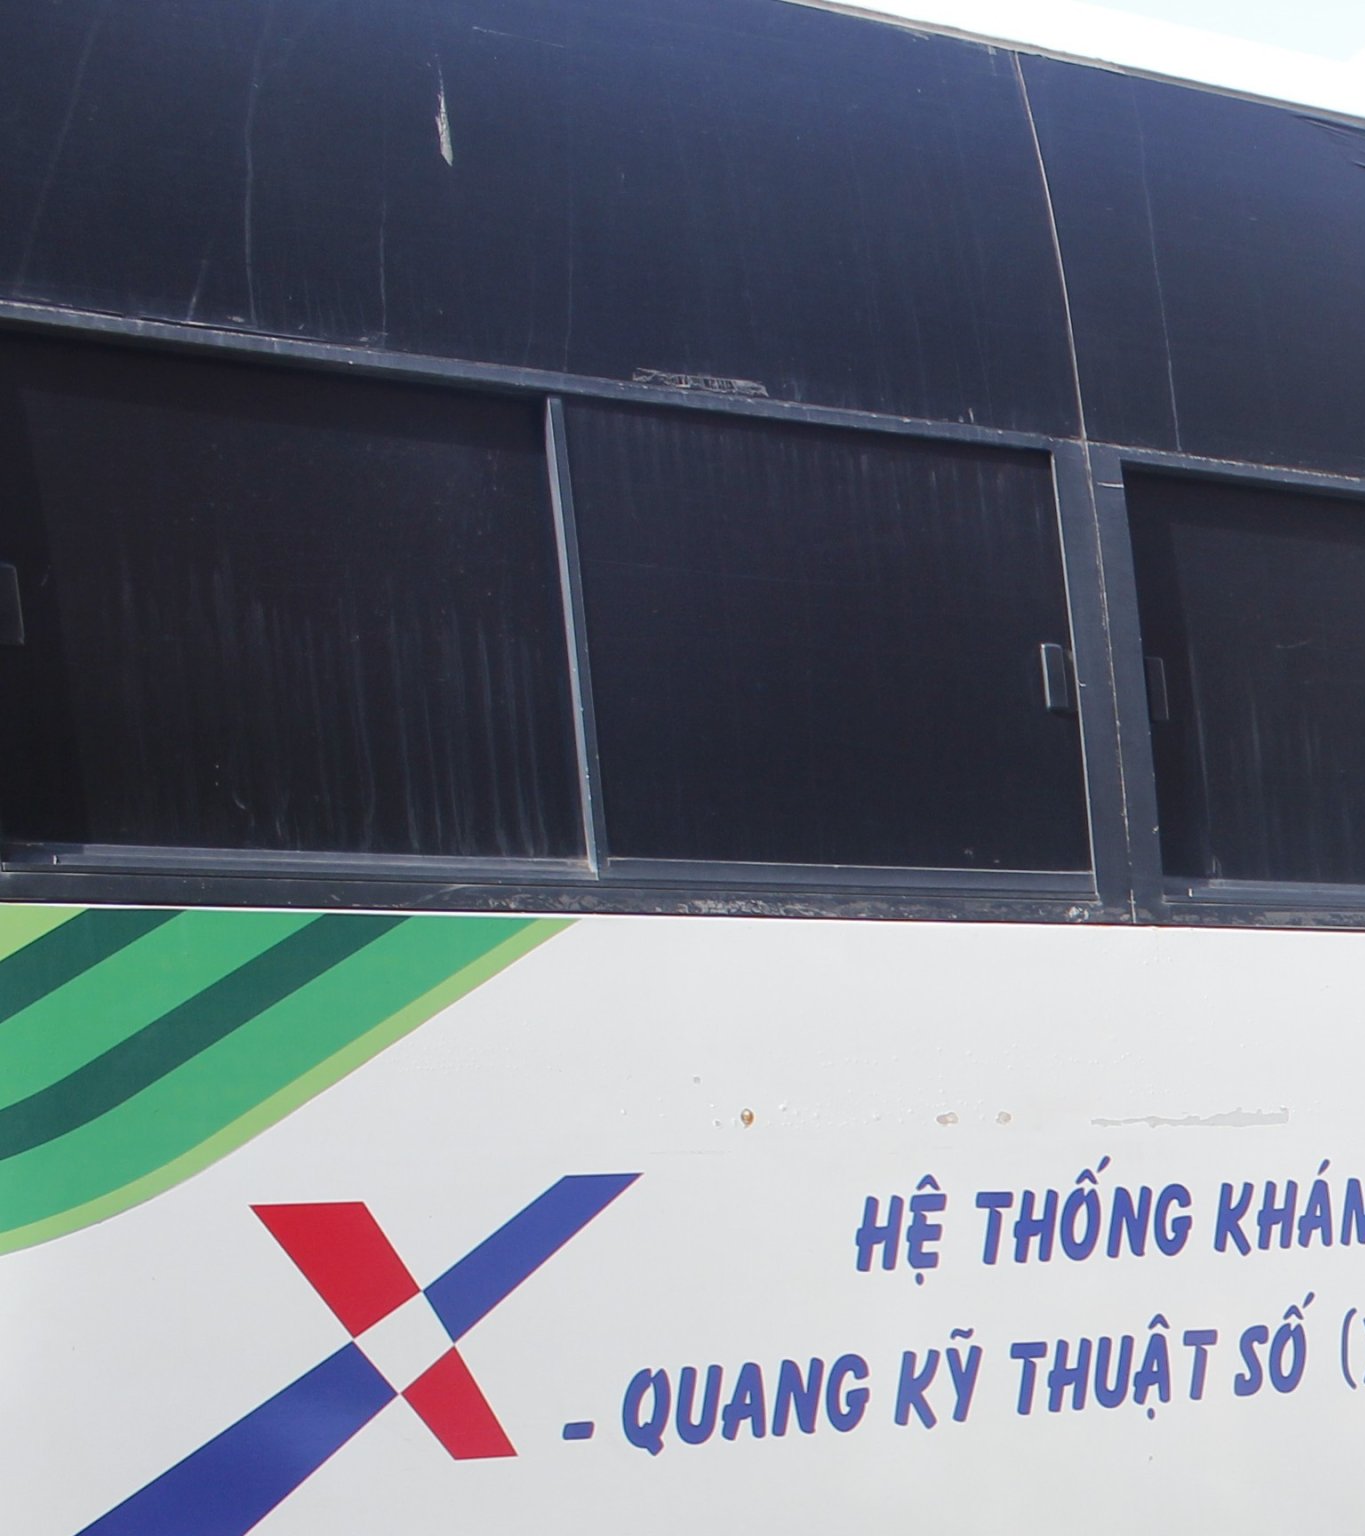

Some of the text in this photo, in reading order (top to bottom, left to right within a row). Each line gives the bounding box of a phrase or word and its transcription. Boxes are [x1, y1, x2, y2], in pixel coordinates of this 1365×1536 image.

[853, 1174, 947, 1286] HỆ
[974, 1155, 1193, 1266] THỐNG
[620, 1353, 871, 1457] QUANG
[893, 1328, 983, 1430] KỸ
[1008, 1313, 1218, 1421] THUẬT
[1233, 1291, 1317, 1398] SỐ
